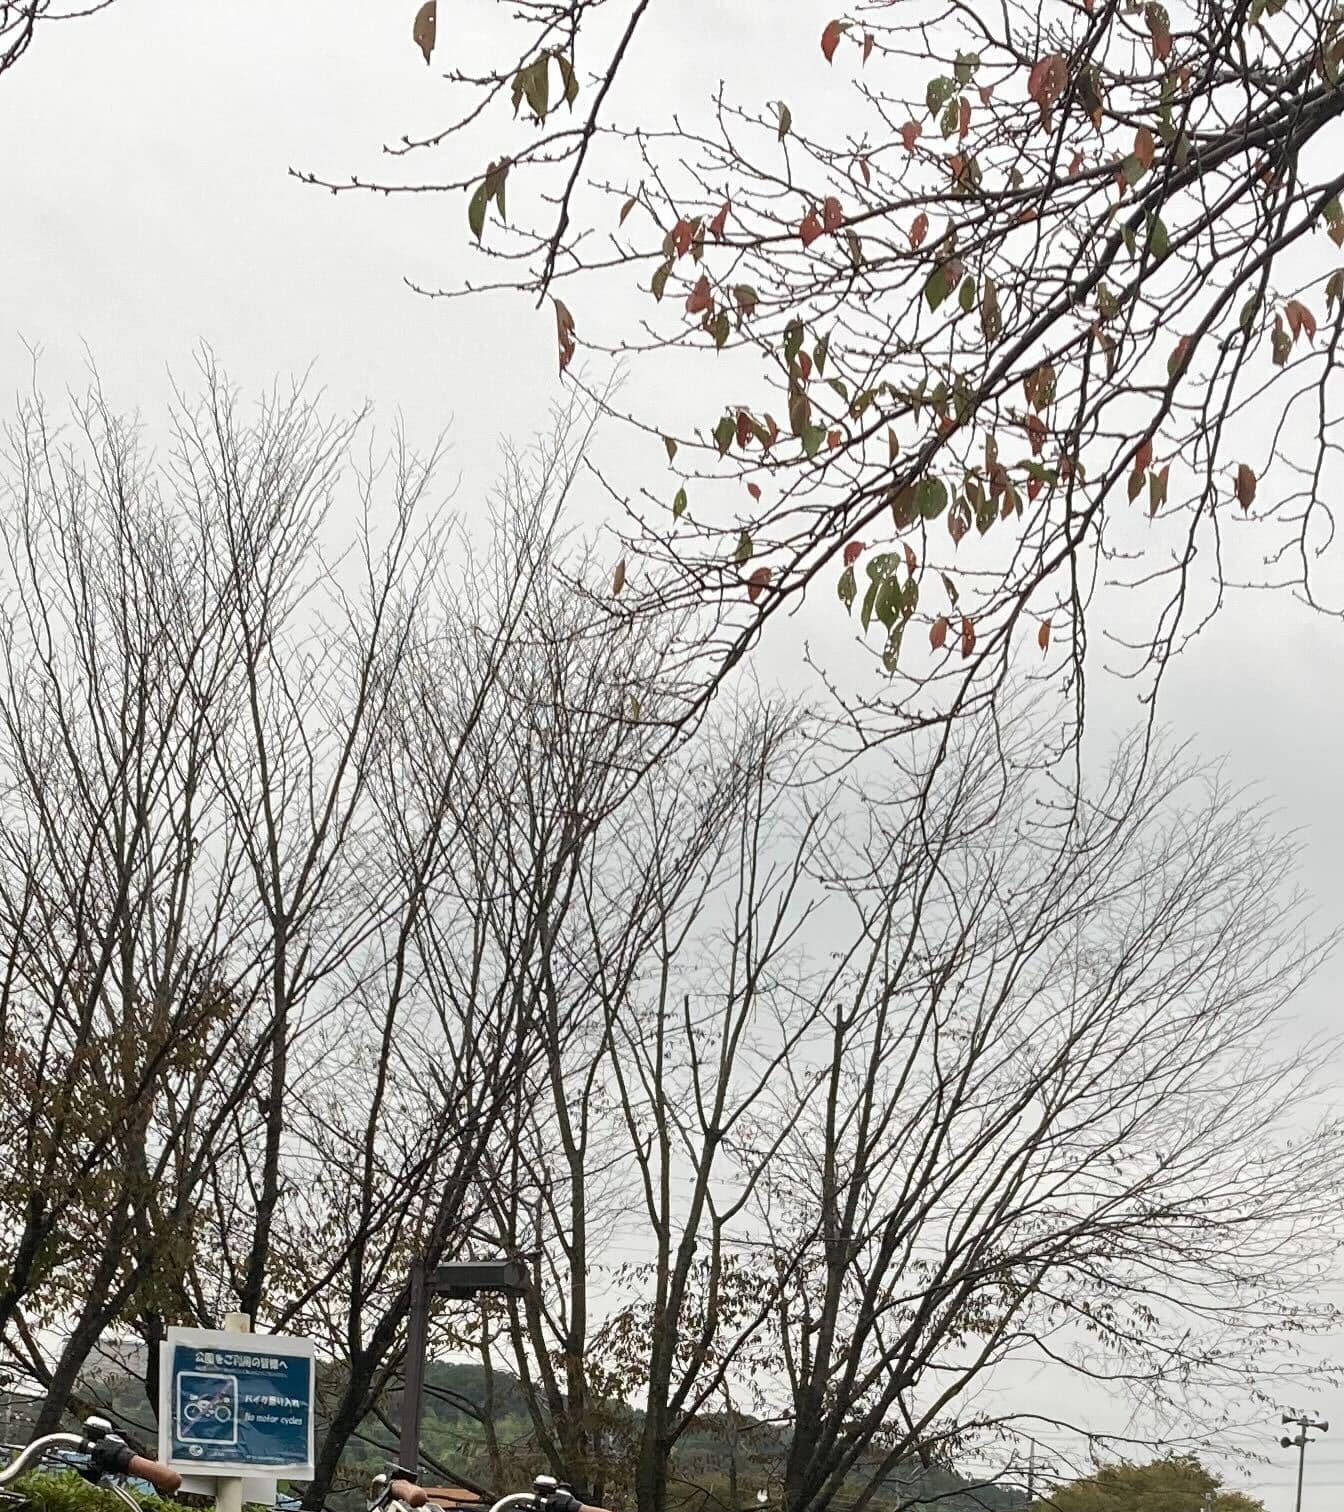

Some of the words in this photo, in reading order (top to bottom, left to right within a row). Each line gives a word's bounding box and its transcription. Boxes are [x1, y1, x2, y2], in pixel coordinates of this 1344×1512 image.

[245, 1412, 255, 1421] No
[256, 1414, 279, 1423] motor
[280, 1415, 303, 1426] cycles
